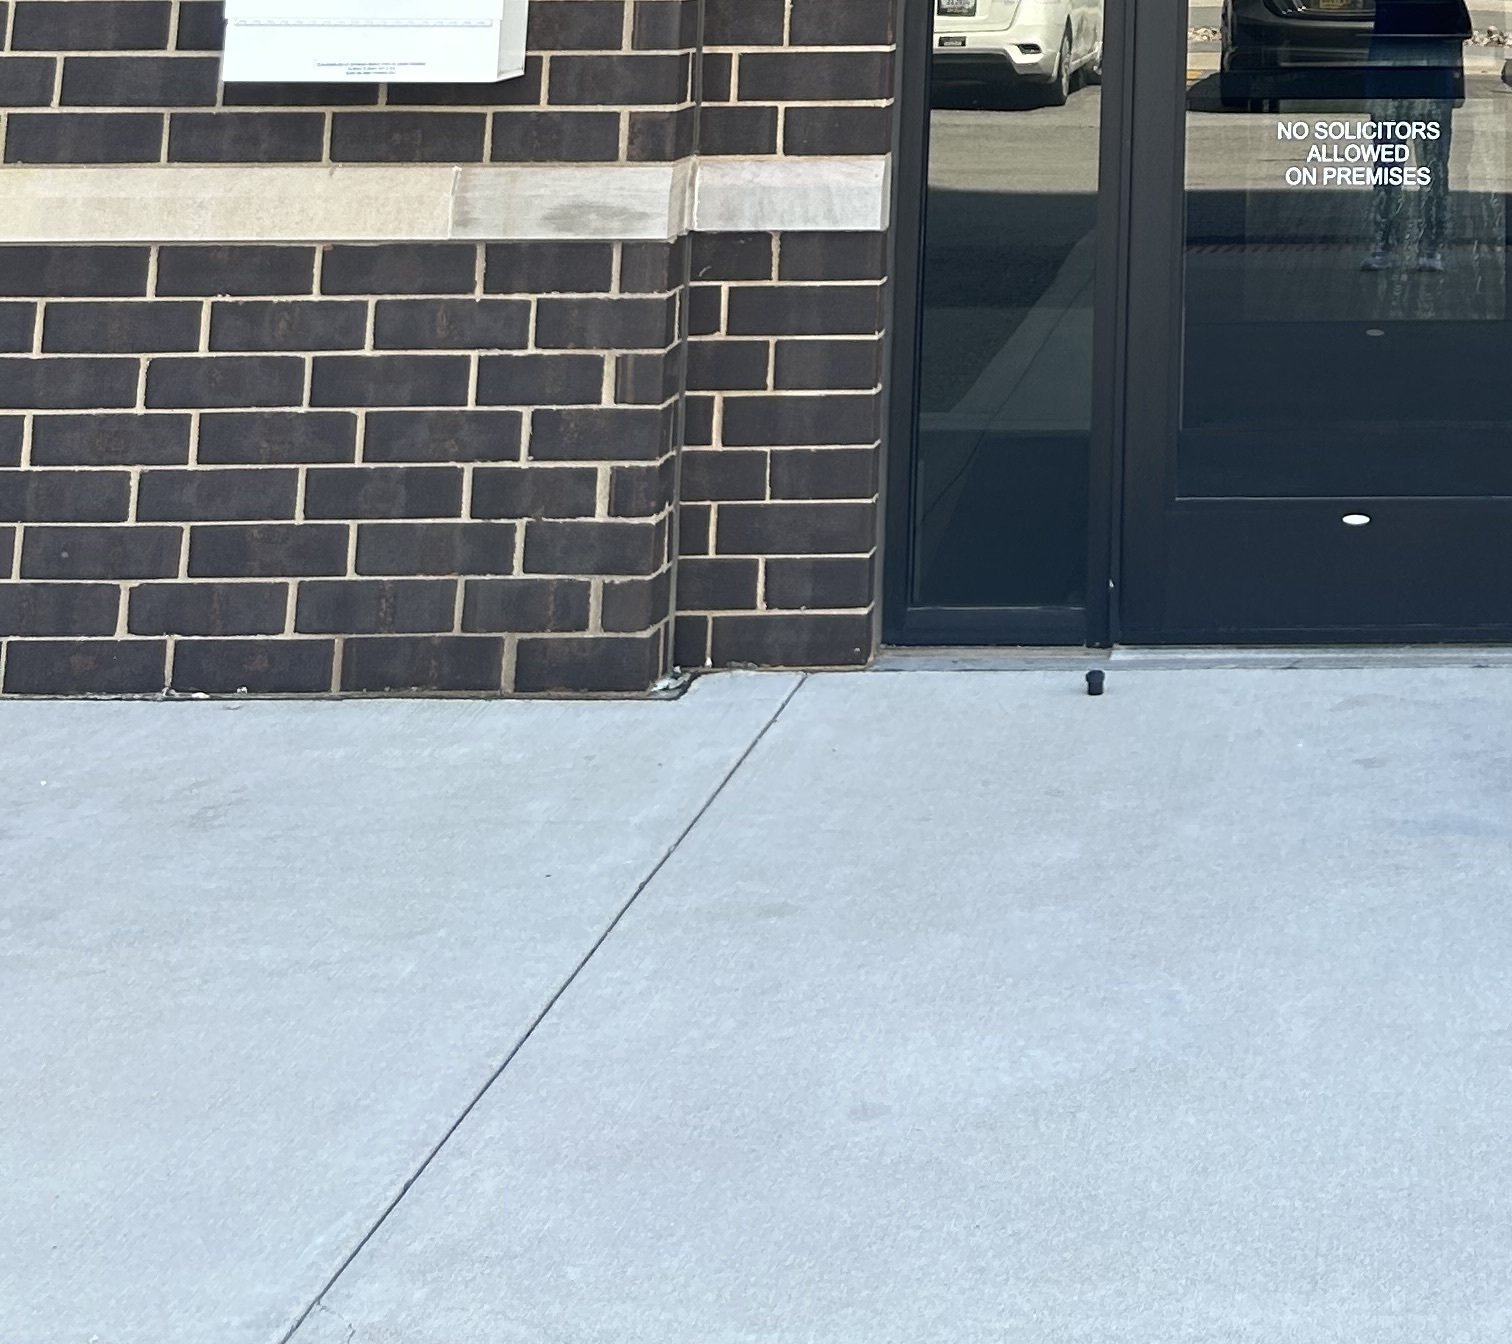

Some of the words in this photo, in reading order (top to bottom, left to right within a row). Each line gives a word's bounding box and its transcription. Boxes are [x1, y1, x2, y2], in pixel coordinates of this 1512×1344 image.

[1277, 121, 1309, 140] NO
[1314, 121, 1440, 140] SOLICITORS
[1306, 144, 1410, 163] ALLOWED
[1285, 167, 1318, 186] ON
[1322, 167, 1432, 186] PREMISES
